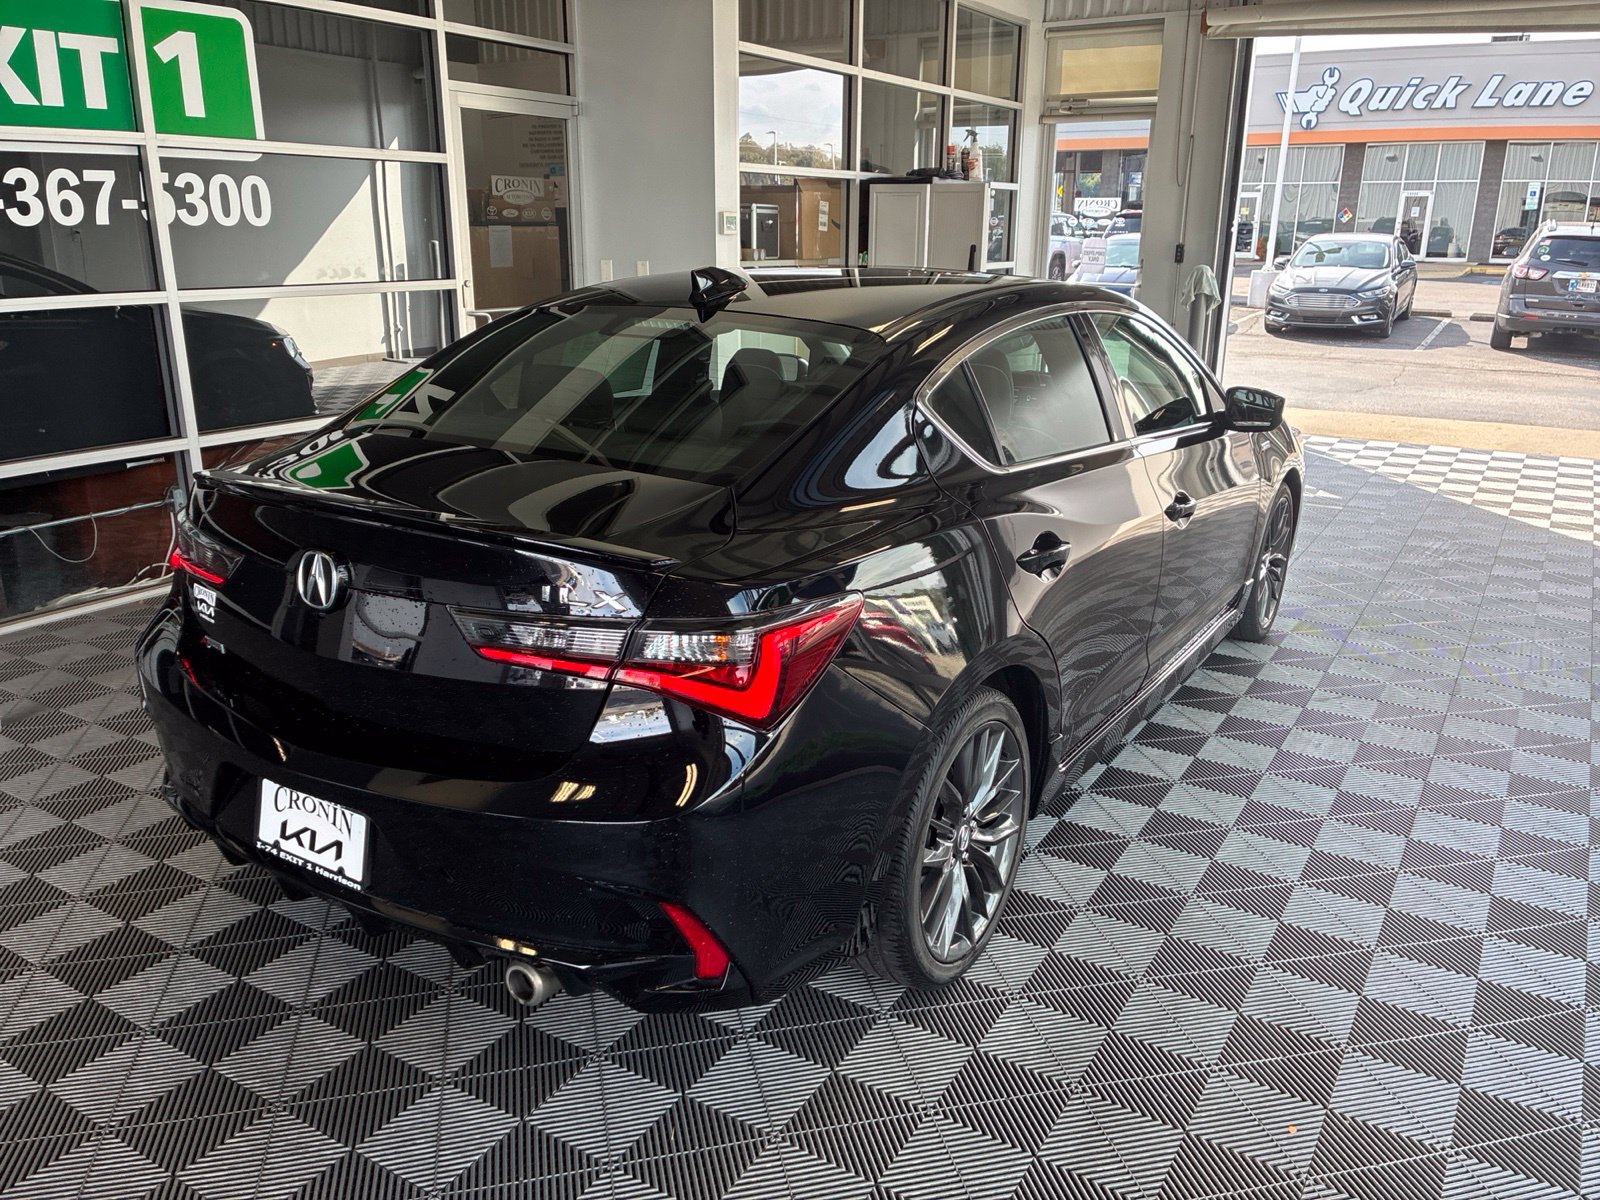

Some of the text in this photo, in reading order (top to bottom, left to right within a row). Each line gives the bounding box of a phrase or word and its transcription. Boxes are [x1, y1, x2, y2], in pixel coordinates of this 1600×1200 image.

[153, 30, 206, 118] 1
[1338, 73, 1595, 116] Quick Lane
[0, 167, 272, 227] 367-5300
[495, 177, 542, 194] CRONIN
[274, 786, 354, 840] CRONIN
[280, 819, 343, 861] KIA
[256, 841, 361, 890] I-74 EXIT 1 Harrison
